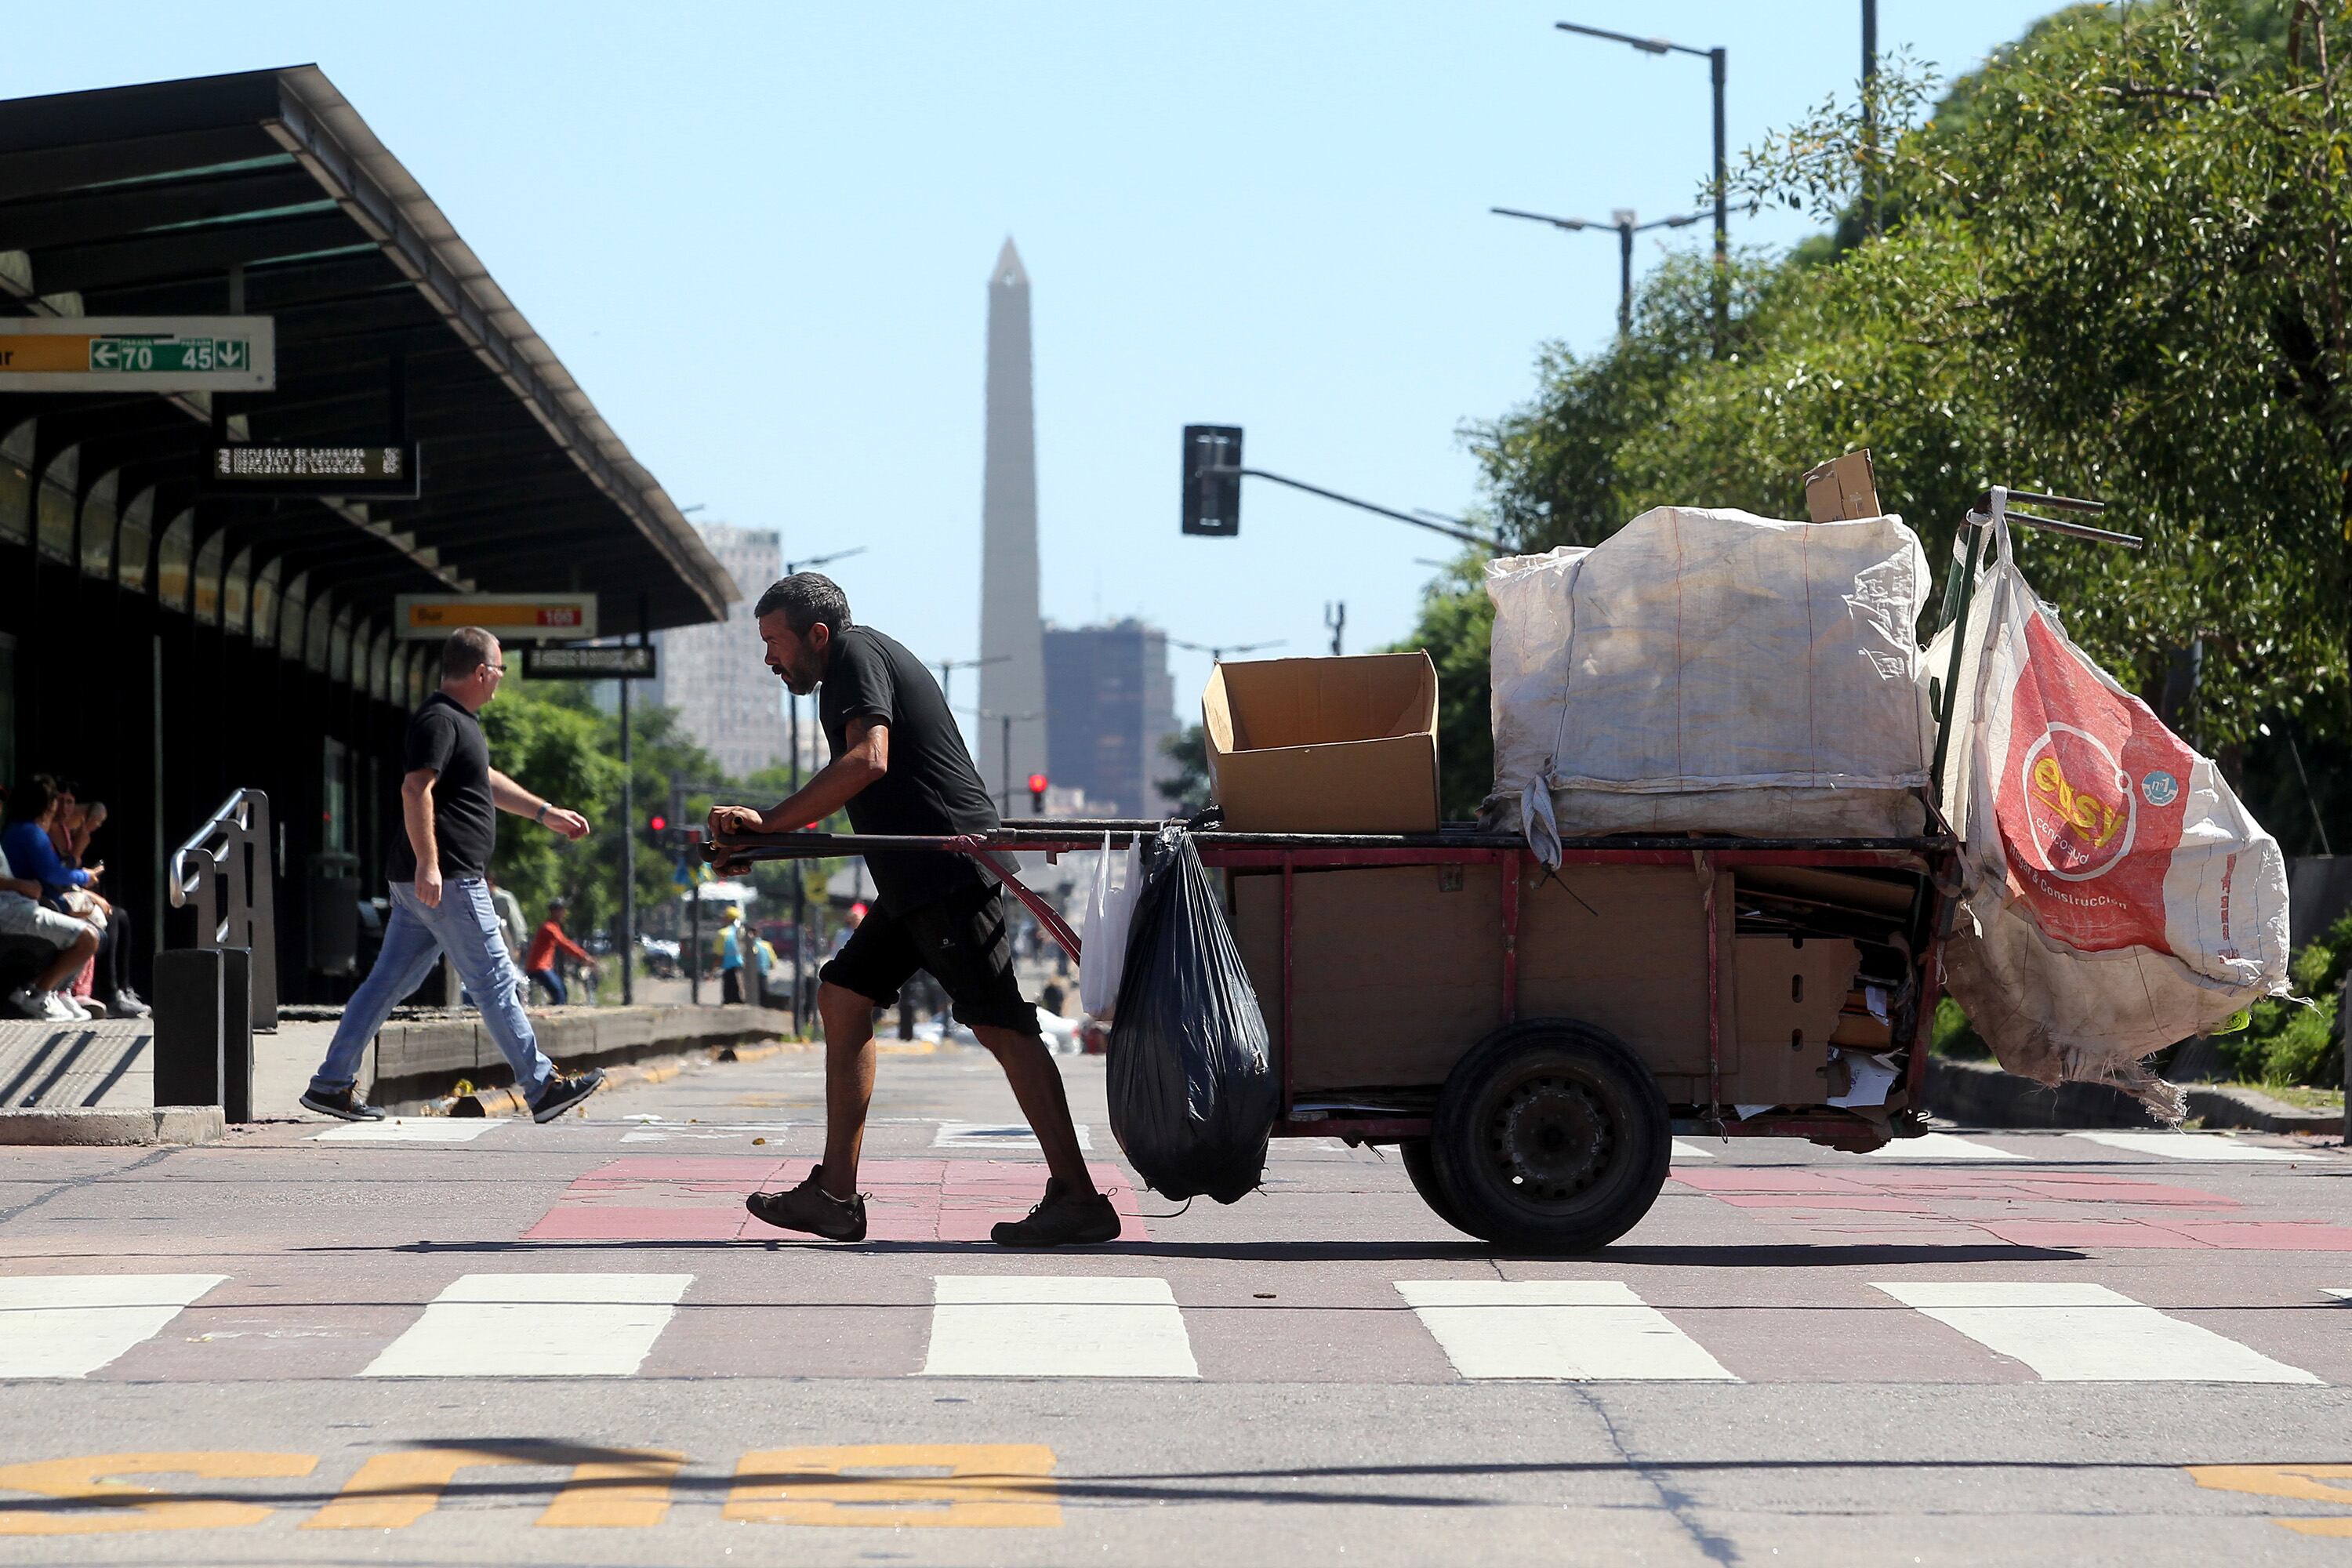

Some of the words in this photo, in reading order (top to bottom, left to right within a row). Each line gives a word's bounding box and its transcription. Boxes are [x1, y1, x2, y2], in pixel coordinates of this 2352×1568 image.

[122, 347, 153, 370] 70
[181, 347, 212, 370] 45
[2034, 757, 2126, 848] easy
[2036, 818, 2089, 865] cencosud
[2032, 869, 2040, 885] &
